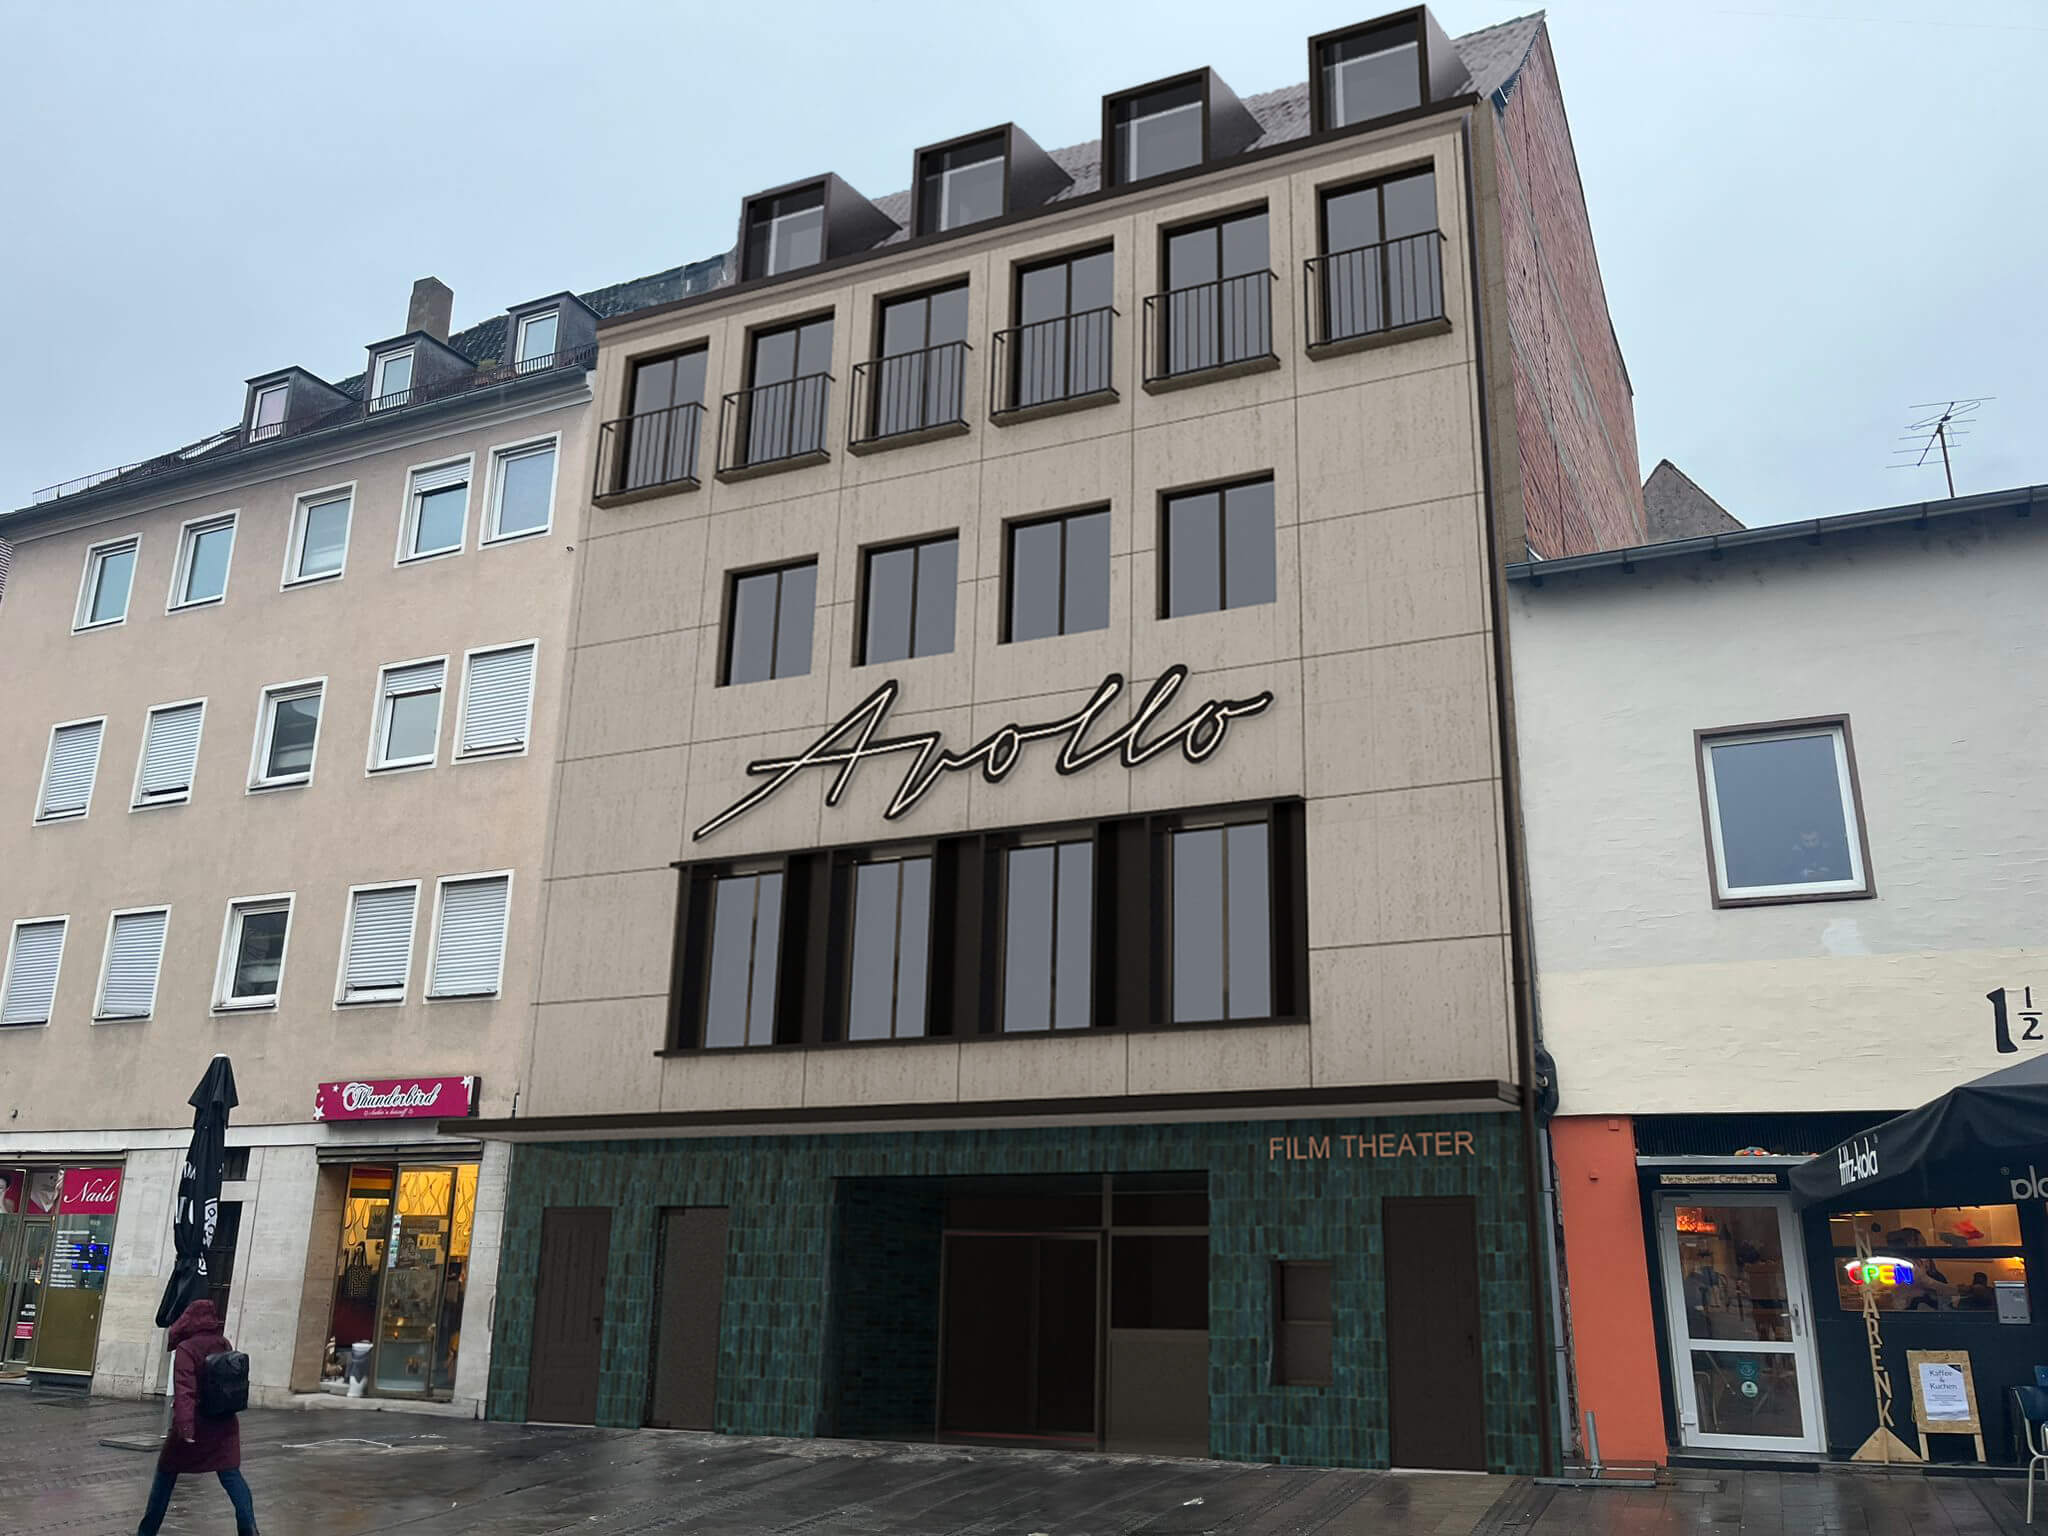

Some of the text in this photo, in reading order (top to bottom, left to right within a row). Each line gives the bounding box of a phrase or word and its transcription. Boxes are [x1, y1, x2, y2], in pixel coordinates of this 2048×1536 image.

[693, 664, 1274, 842] Apollo
[342, 1082, 443, 1111] Thunderbird
[1269, 1131, 1475, 1160] FILM THEATER
[64, 1179, 117, 1203] Nails
[1848, 1264, 1914, 1286] OPEN
[1929, 1382, 1958, 1391] Kuchen
